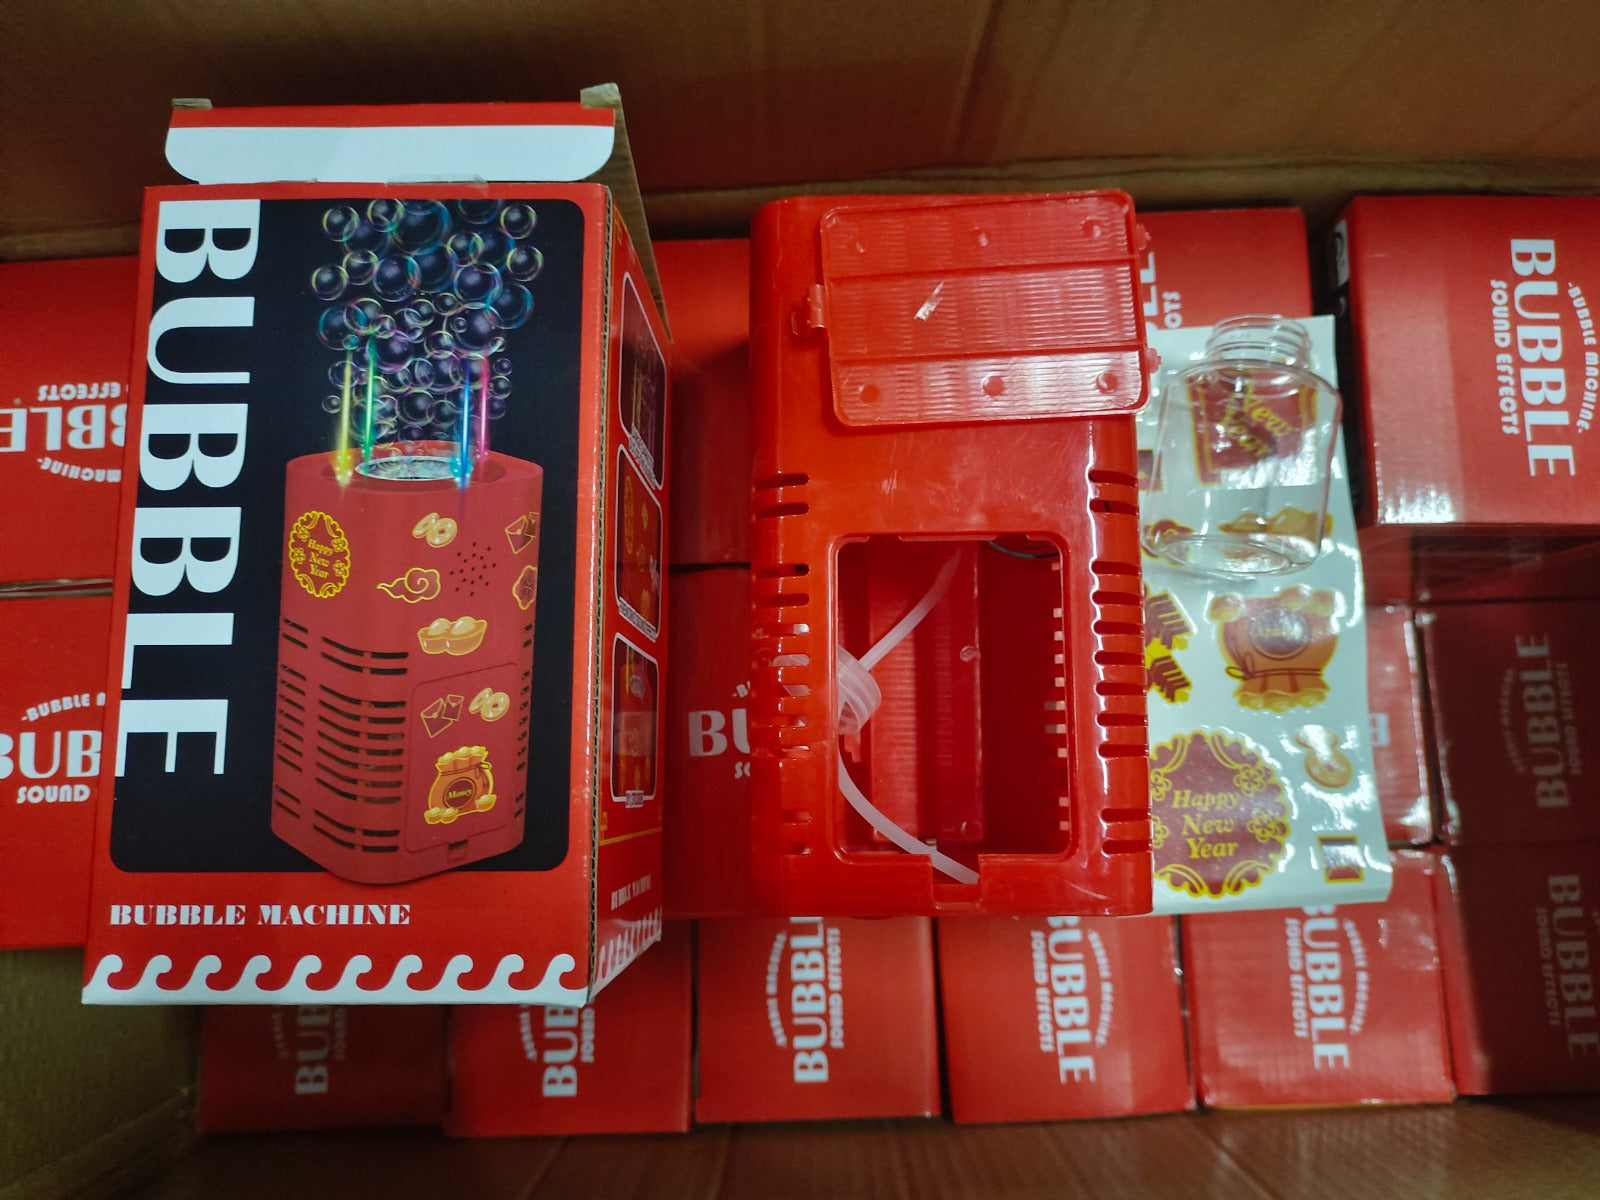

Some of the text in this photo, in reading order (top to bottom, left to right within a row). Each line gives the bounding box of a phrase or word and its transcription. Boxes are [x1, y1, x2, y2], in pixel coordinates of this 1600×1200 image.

[1490, 279, 1520, 435] SOUND EFFECTS
[1510, 238, 1576, 478] BUBBLE
[113, 198, 261, 779] BUBBLE
[1514, 632, 1570, 809] BUBBLE
[16, 783, 91, 804] SOUND
[1169, 788, 1241, 812] Happy
[1181, 812, 1236, 837] New
[1185, 836, 1240, 860] Year
[109, 903, 412, 926] BUBBLE MACHINE
[1548, 874, 1600, 1059] BUBBLE
